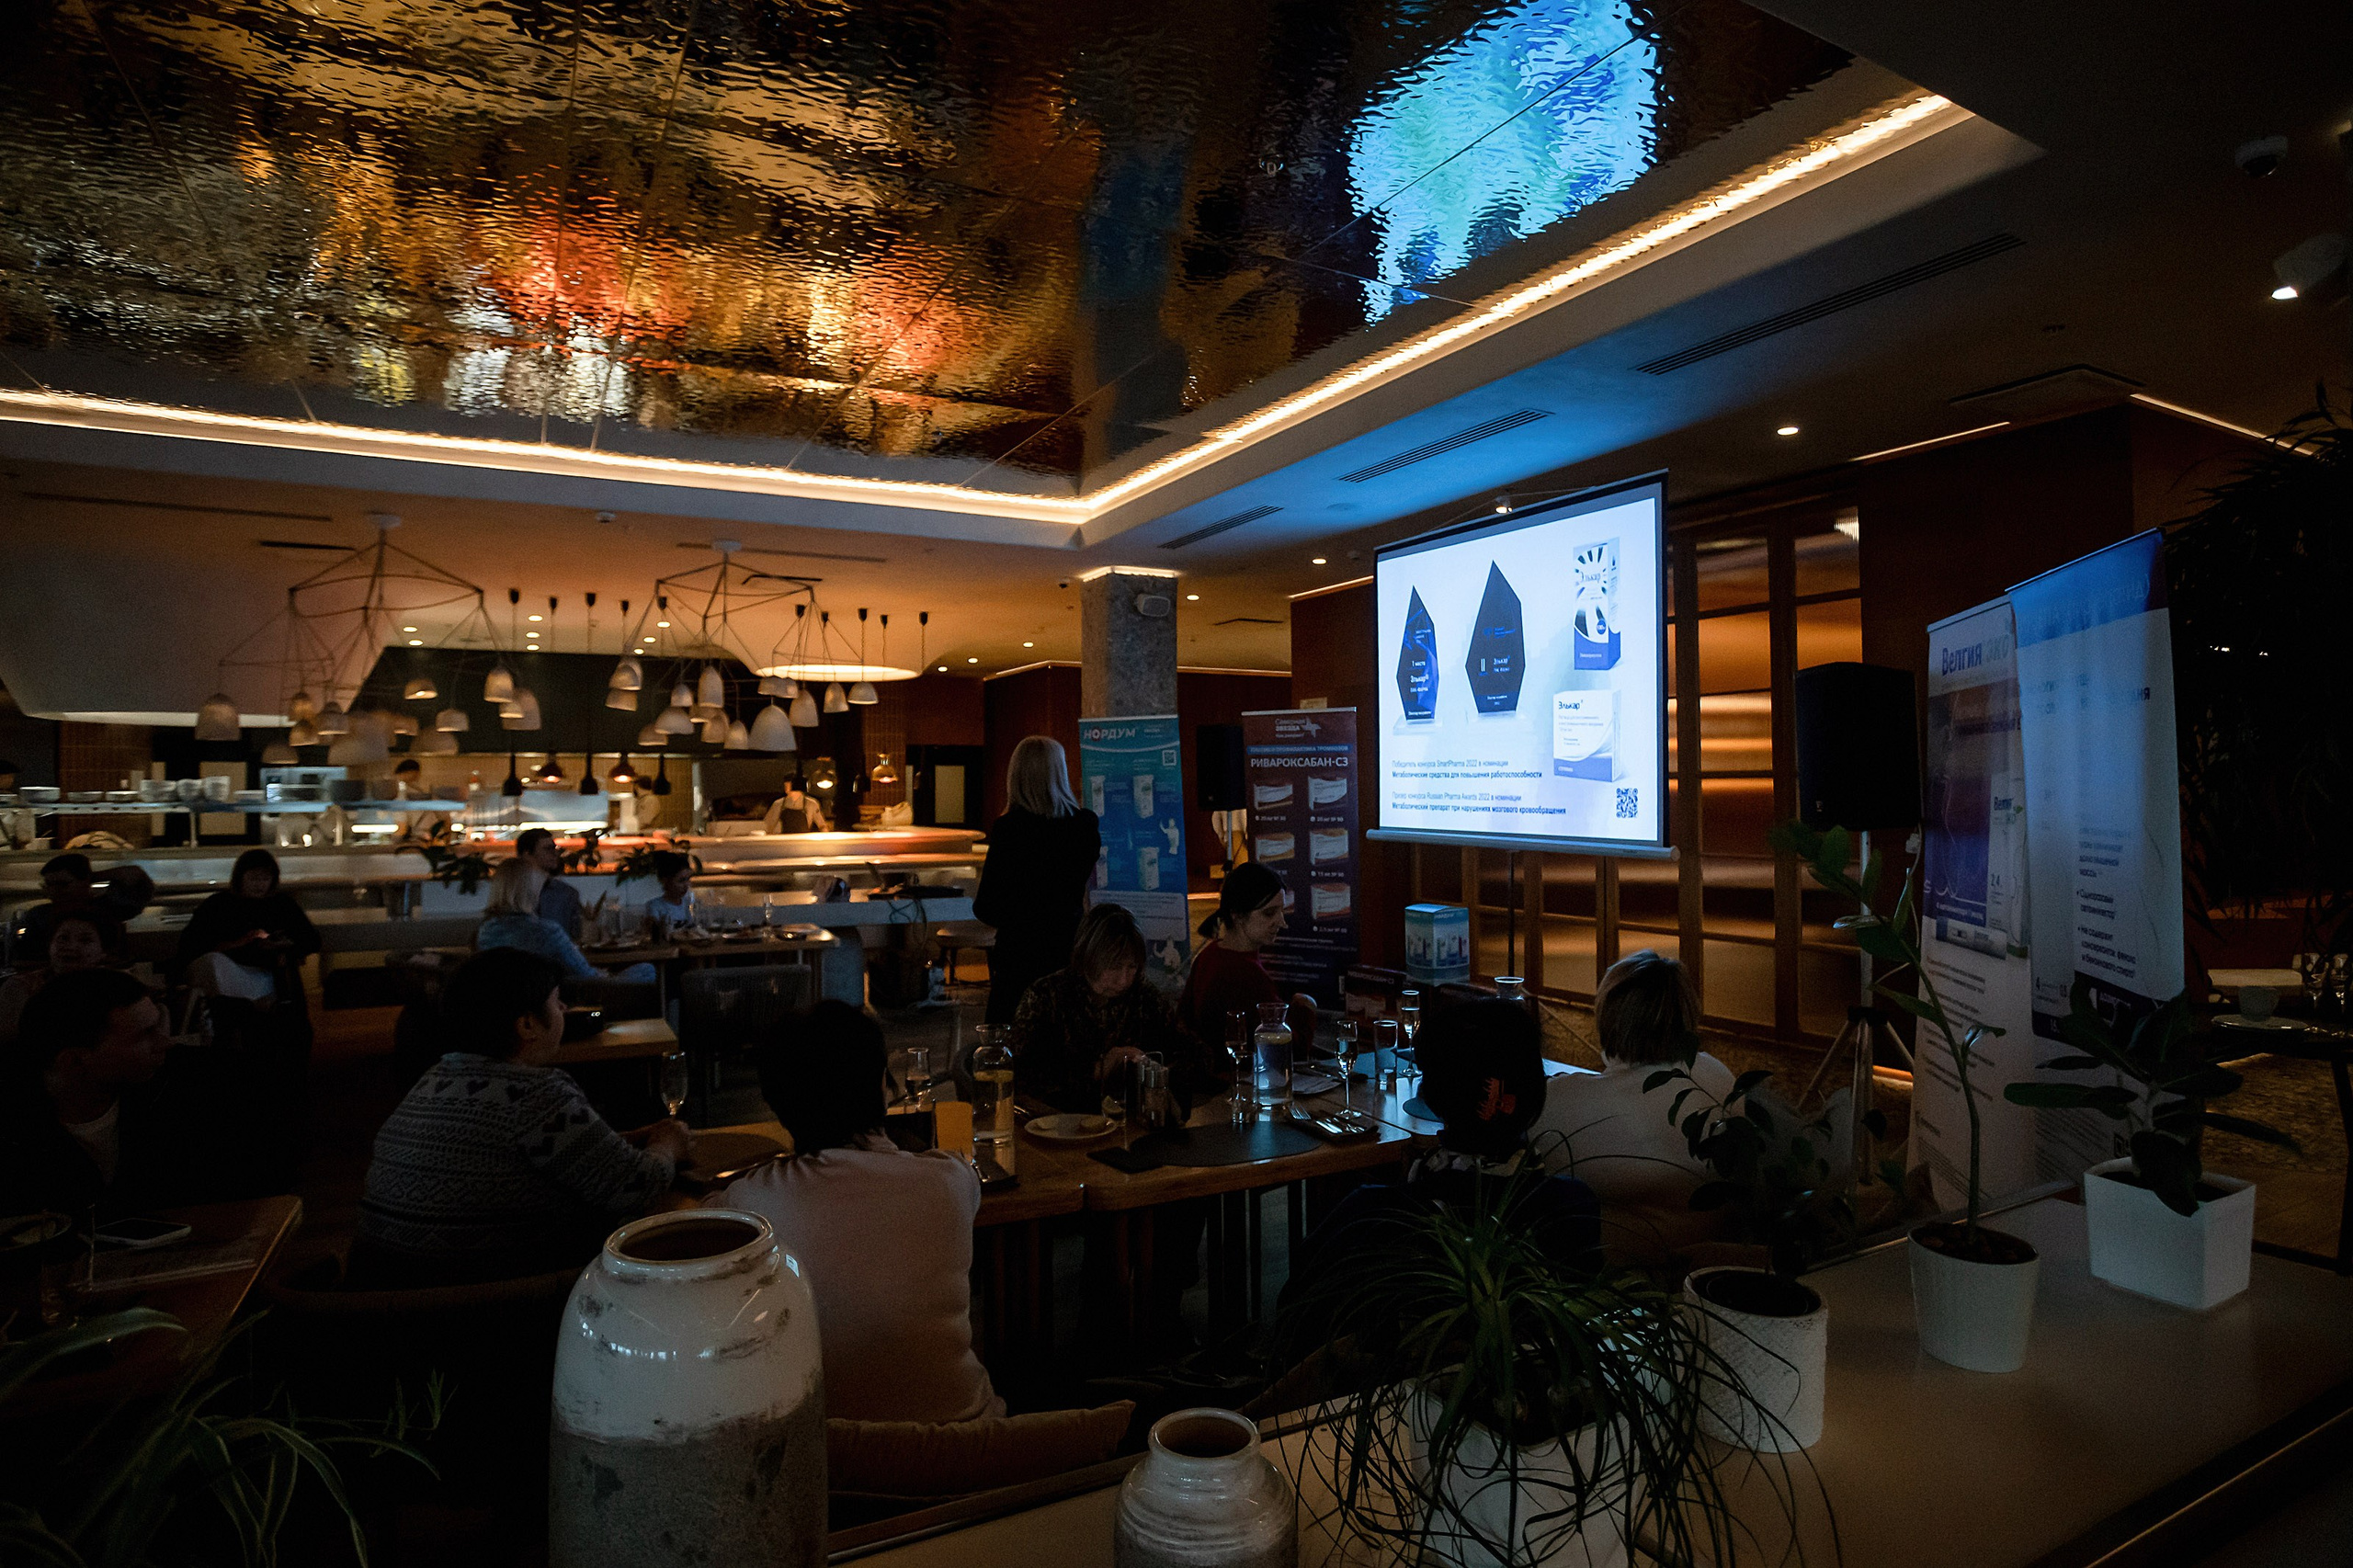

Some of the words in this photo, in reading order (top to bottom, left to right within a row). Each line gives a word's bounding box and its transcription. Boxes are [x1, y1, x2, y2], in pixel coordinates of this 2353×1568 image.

[1942, 642, 1982, 676] Велгия
[1084, 727, 1136, 741] НОРДУМ
[1250, 756, 1348, 767] РИВАРОКСАБАН-СЗ
[1491, 770, 1542, 778] работоспособности
[1519, 805, 1566, 814] кровообращения
